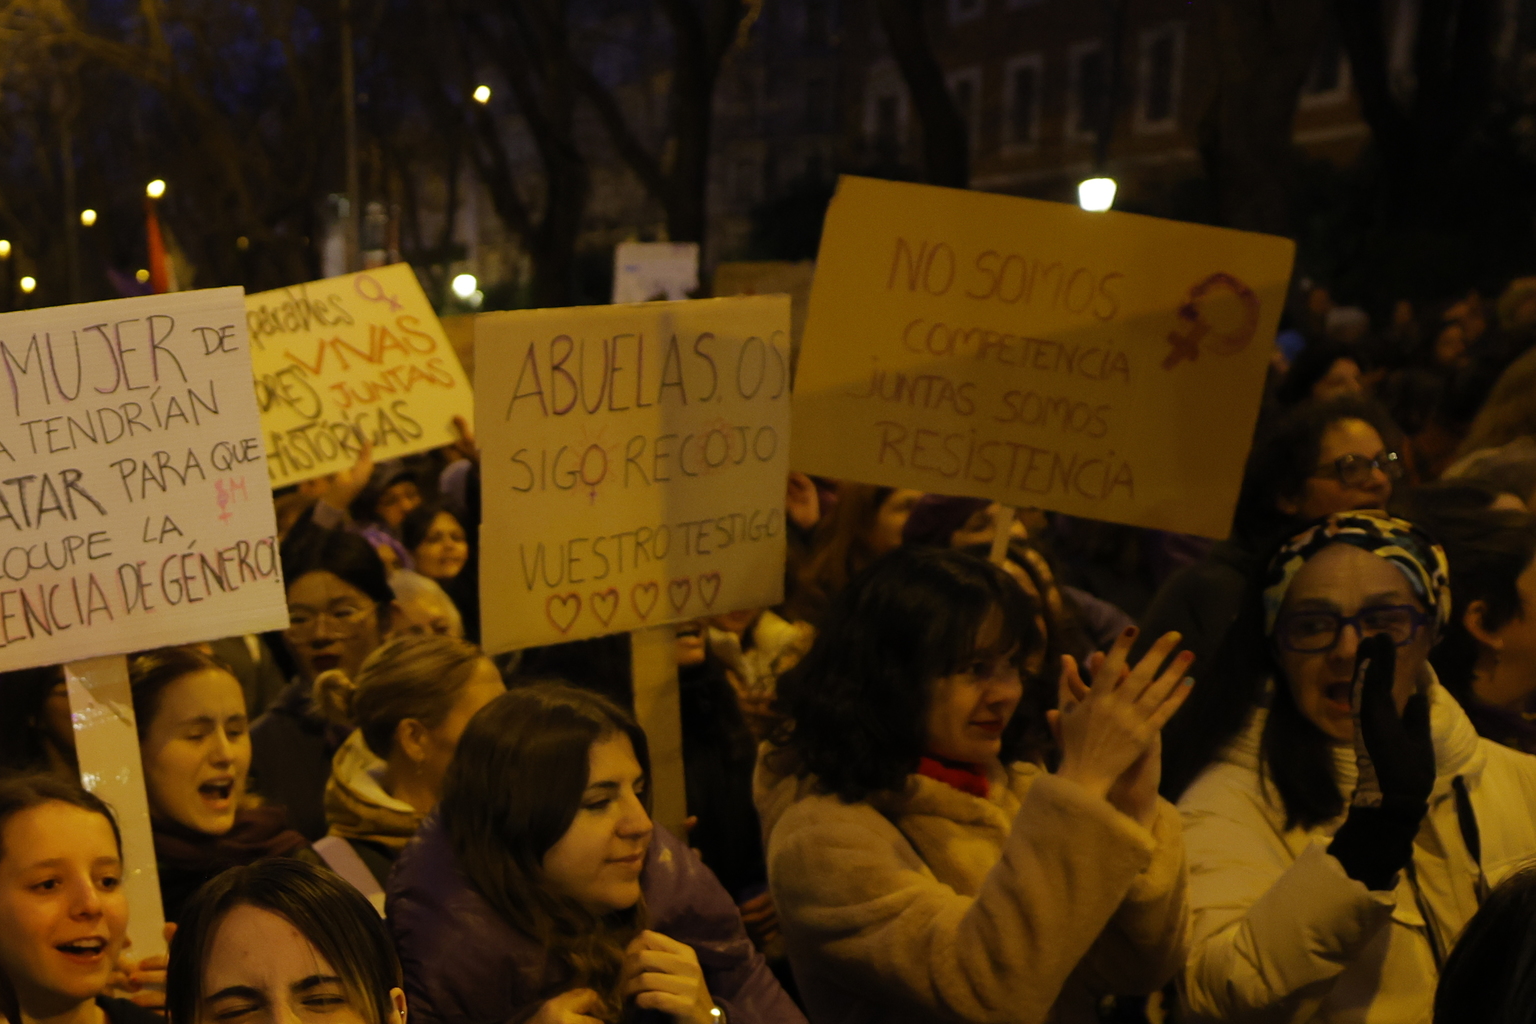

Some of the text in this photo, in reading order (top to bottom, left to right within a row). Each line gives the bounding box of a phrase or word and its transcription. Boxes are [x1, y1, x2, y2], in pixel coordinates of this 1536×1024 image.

[886, 236, 1126, 323] NO SOMOS
[0, 315, 187, 416] MUJER
[191, 325, 239, 355] DE
[283, 315, 436, 376] VIVAS
[737, 329, 786, 401] OS
[20, 379, 219, 454] TENDRÍAN
[328, 358, 455, 409] JUNTAS
[842, 356, 1112, 439] JUNTAS SOMOS
[110, 448, 206, 502] PARA
[210, 437, 260, 472] QUE
[510, 425, 778, 493] SIGO RECOJO
[142, 515, 184, 543] LA
[519, 508, 780, 592] VUESTRO TESTIGO
[118, 561, 155, 615] DE
